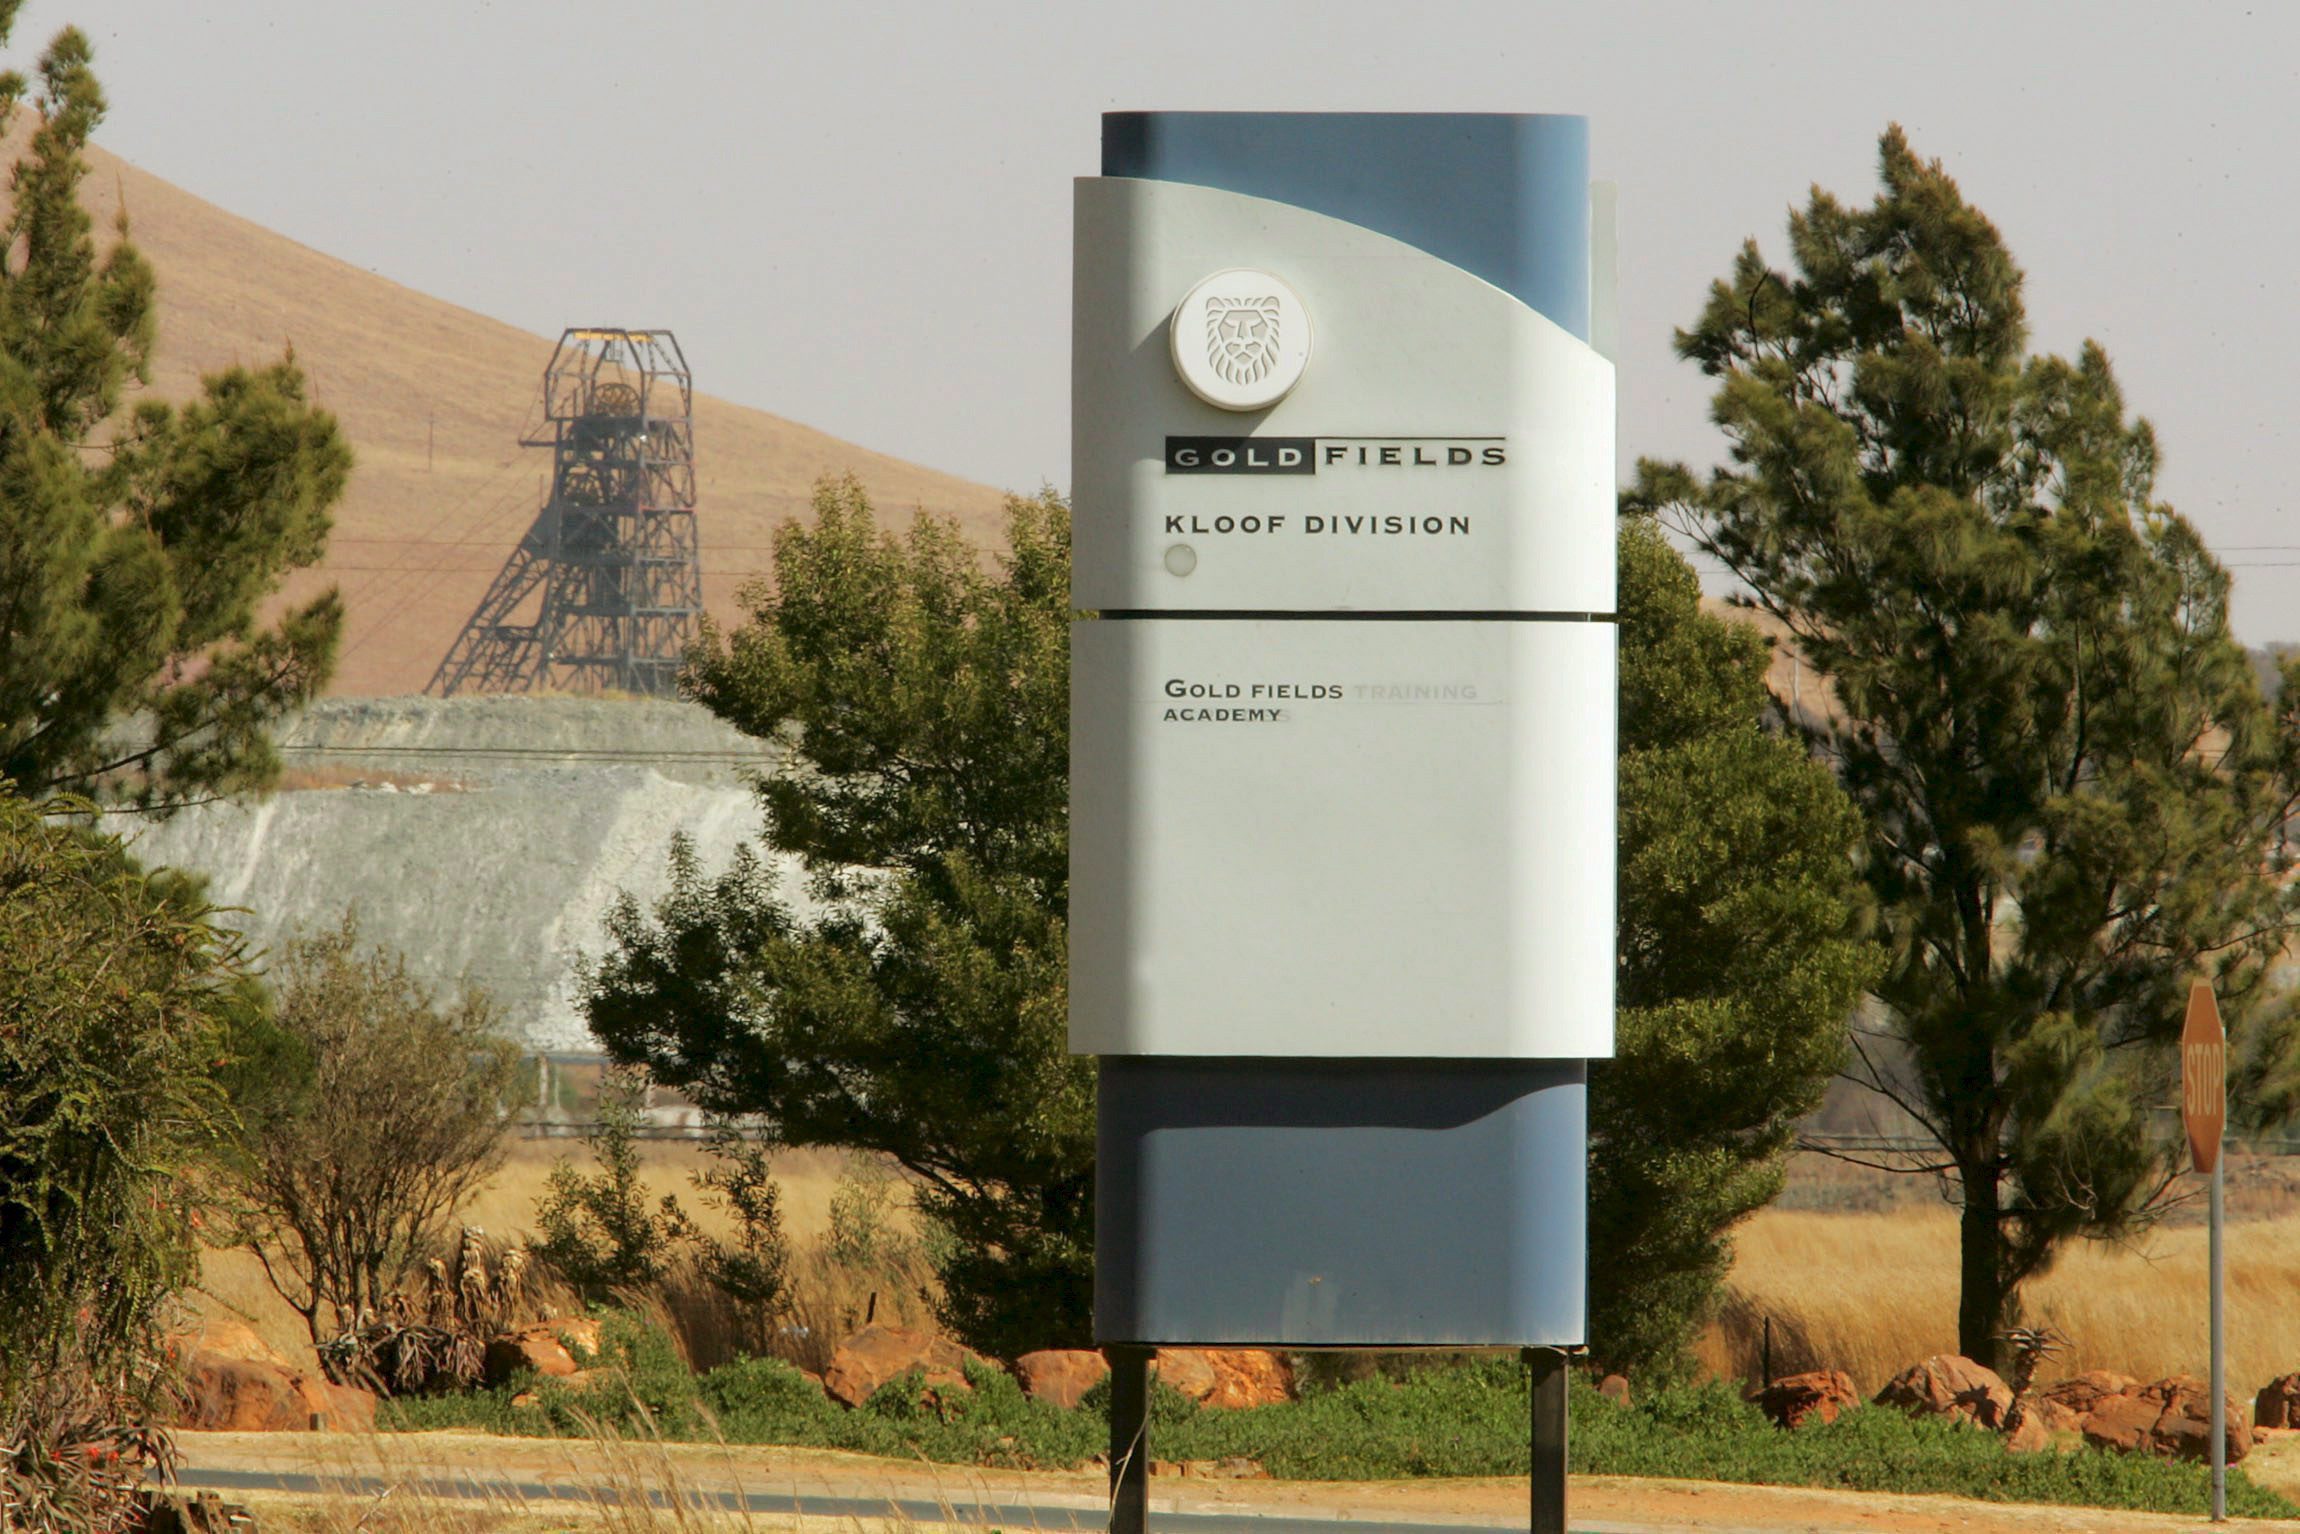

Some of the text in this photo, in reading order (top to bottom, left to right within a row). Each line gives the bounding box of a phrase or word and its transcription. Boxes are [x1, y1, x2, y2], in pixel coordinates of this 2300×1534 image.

[1175, 447, 1506, 467] GOLD FIELDS
[1165, 515, 1470, 535] KLOOF DIVISION
[1251, 683, 1343, 699] FIELDS
[1355, 683, 1478, 700] TRAINING
[1163, 708, 1282, 722] ACADEMY
[2187, 1043, 2220, 1116] STOP
